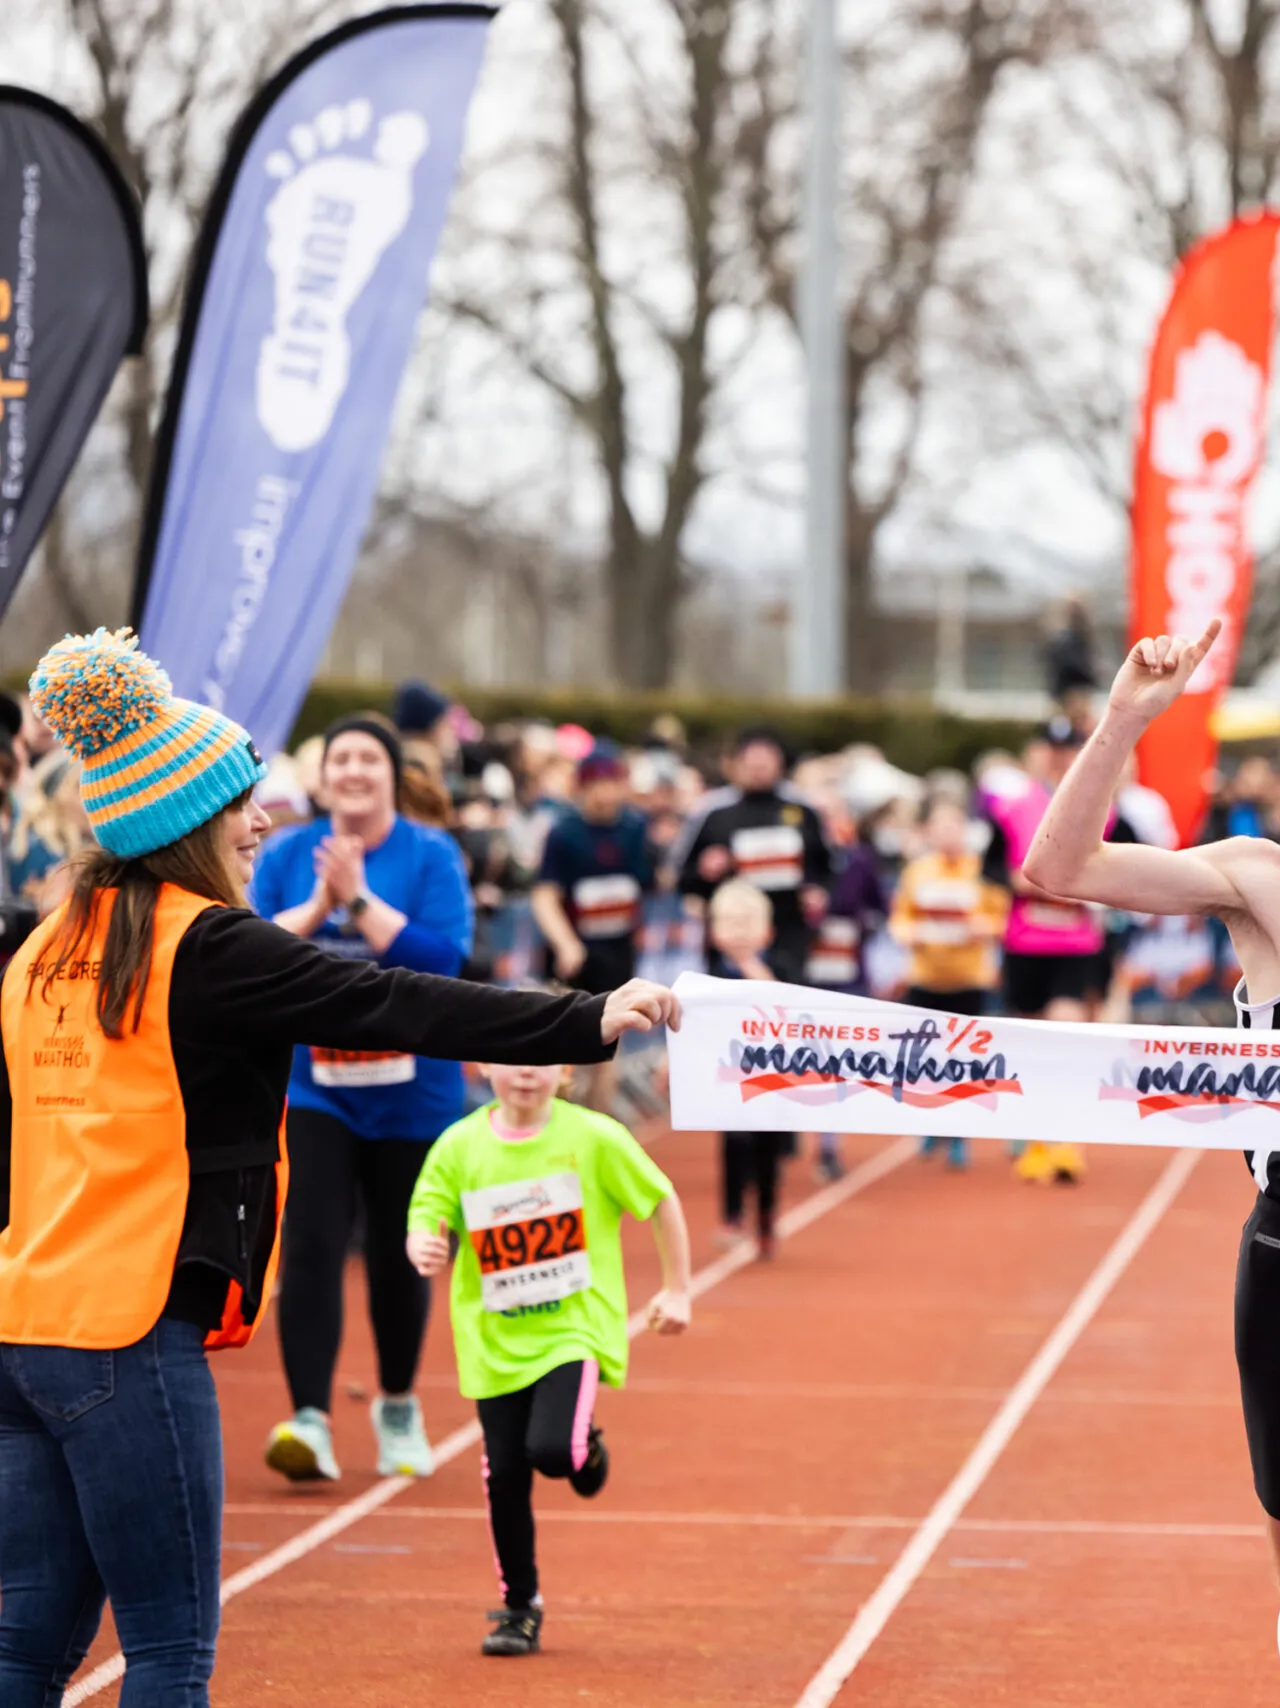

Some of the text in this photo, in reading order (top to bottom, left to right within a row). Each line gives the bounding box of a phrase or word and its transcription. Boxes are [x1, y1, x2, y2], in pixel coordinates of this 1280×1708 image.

[274, 193, 356, 390] RUN4IT
[738, 1018, 1018, 1104] marathon
[741, 1018, 880, 1042] INVERNESS
[481, 1212, 583, 1271] 4922
